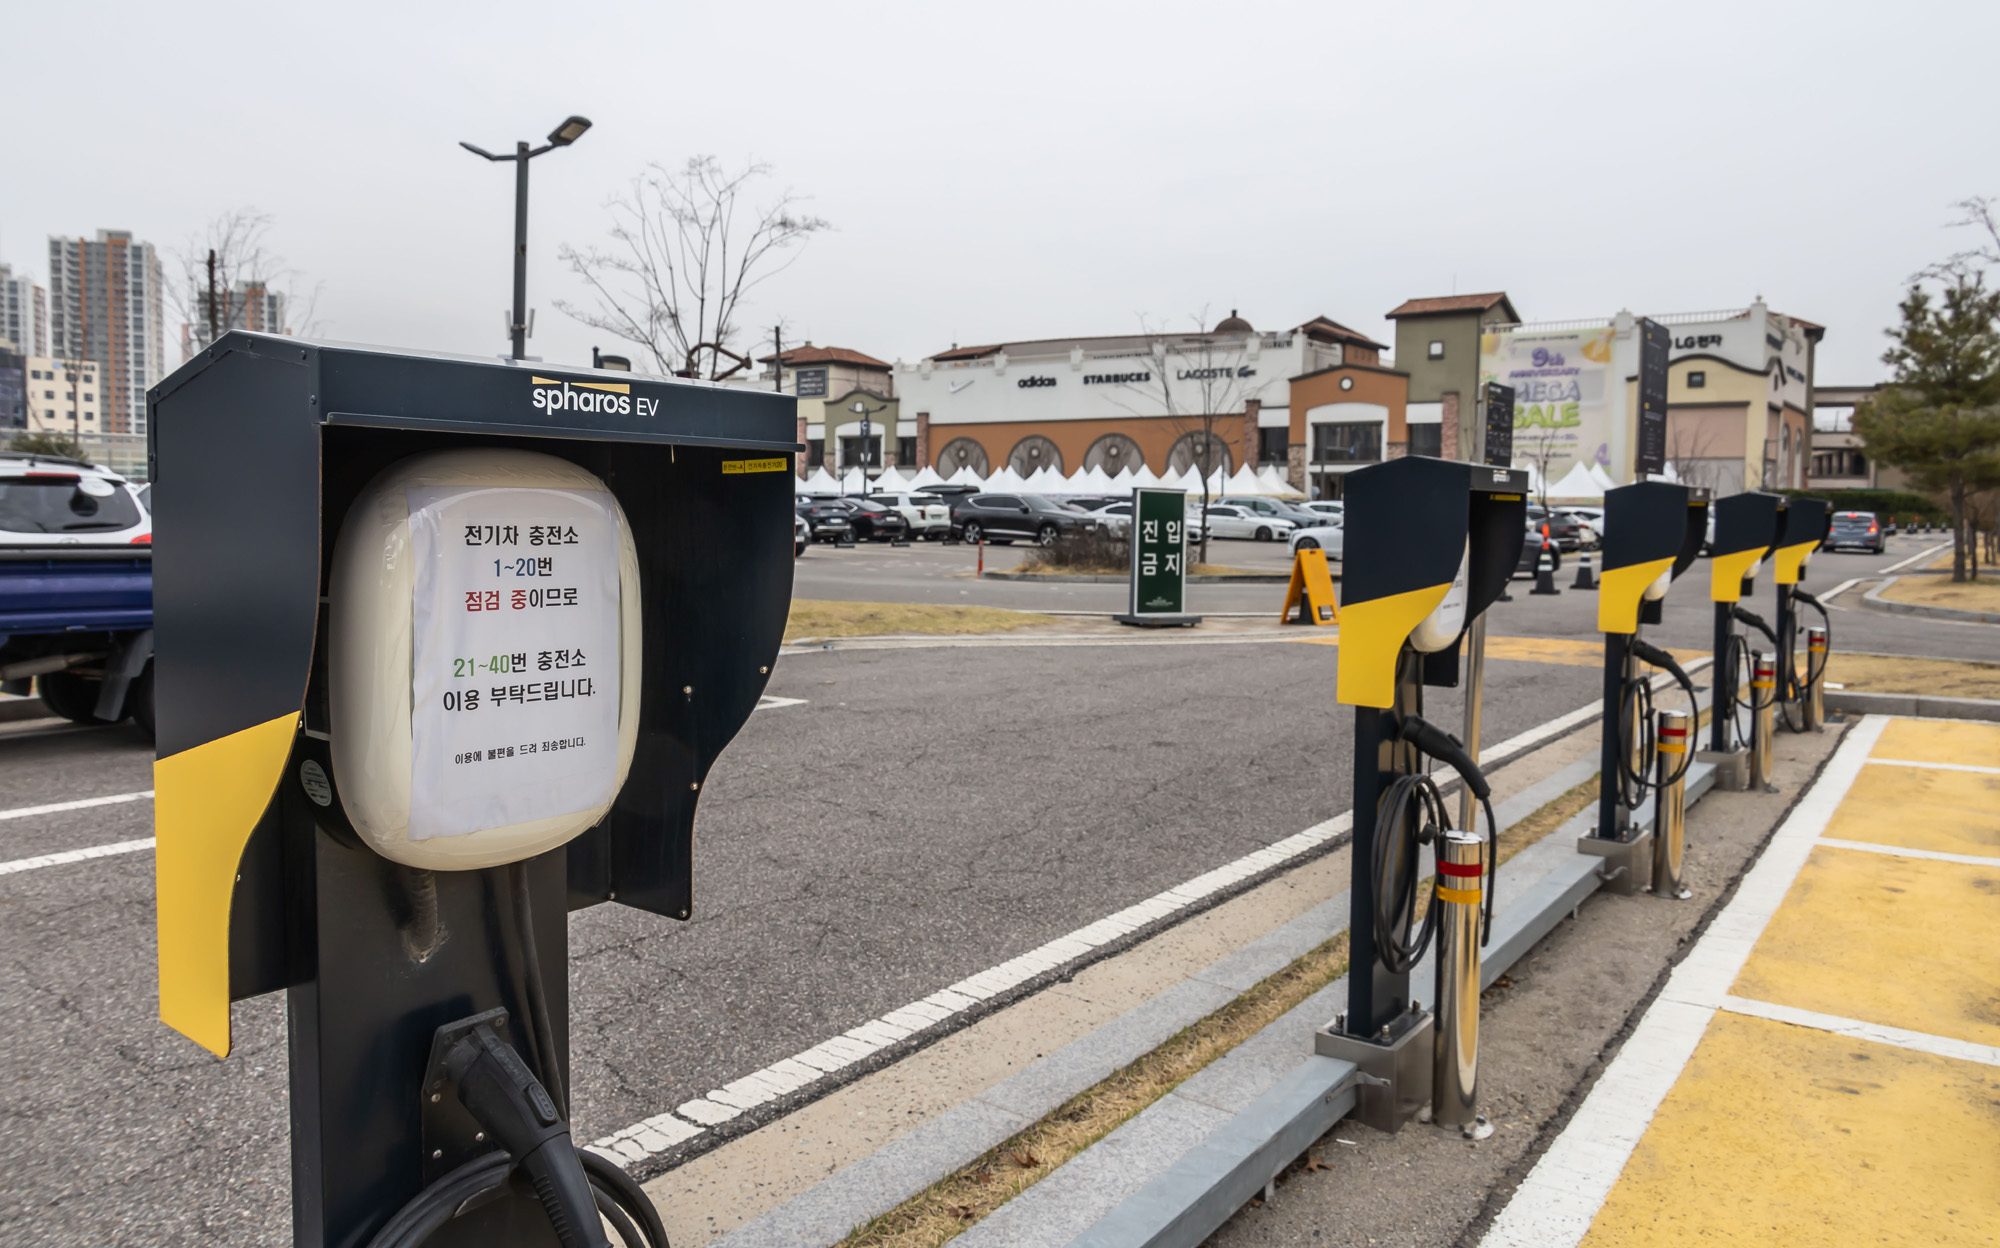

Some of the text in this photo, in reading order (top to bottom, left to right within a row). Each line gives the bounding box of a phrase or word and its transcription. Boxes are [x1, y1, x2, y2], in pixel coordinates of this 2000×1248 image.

[1018, 375, 1057, 388] adidas
[1083, 372, 1150, 385] STARBUCKS
[1176, 367, 1234, 381] LACOSTE
[532, 381, 659, 417] spharos EV
[464, 525, 579, 546] 전기차 충전소
[494, 557, 553, 577] 1~20번
[464, 587, 578, 612] 점검 중이므로
[453, 649, 587, 678] 21~40번 충전소
[443, 678, 596, 711] 이용 부탁드립니다.
[455, 736, 586, 764] 이용에 불편을 드려 죄송합니다.
